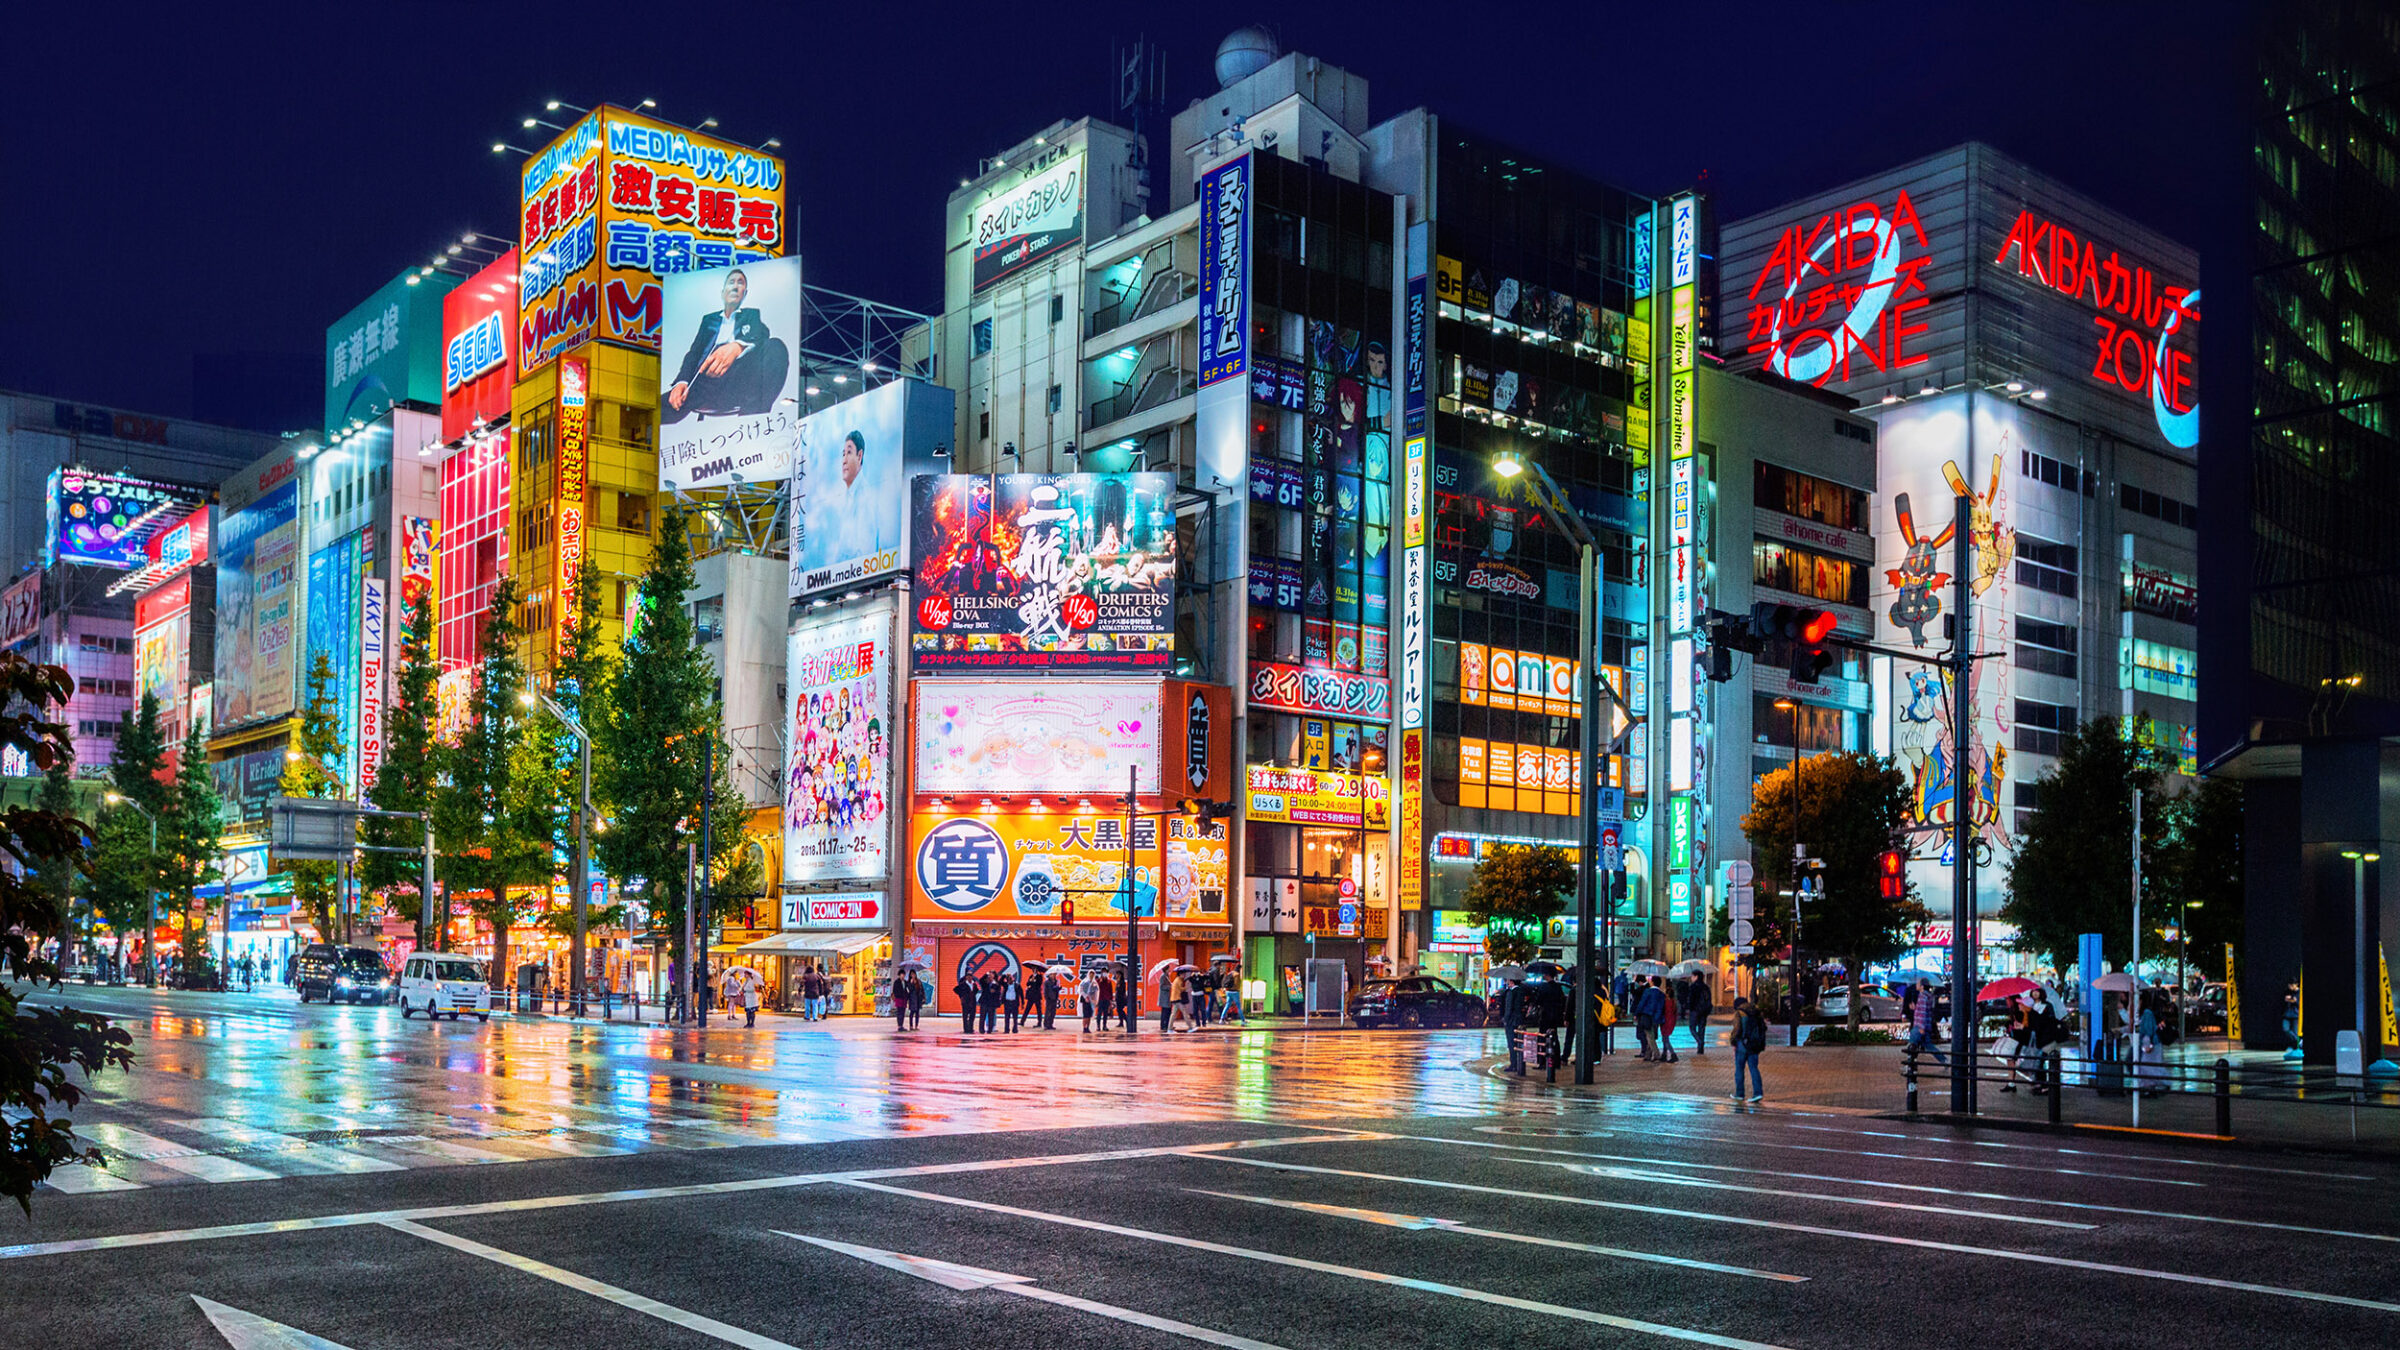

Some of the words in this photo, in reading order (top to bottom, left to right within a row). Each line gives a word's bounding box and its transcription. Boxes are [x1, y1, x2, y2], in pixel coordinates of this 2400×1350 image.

[609, 121, 780, 190] MEDIAリサイクル
[524, 155, 598, 254] 激安販売
[610, 161, 779, 243] 激安販売
[979, 171, 1076, 245] メイドカジノ
[1677, 205, 1691, 278] スーパービル
[1749, 190, 1929, 300] AKIBA
[1437, 270, 1461, 295] 8F
[1747, 256, 1931, 341] カルチャーズ
[522, 280, 597, 368] Mulan
[1203, 303, 1212, 362] 秋葉原店
[447, 310, 507, 392] SEGA
[1674, 325, 1686, 367] Yellow
[2092, 316, 2192, 414] ZONE
[1281, 384, 1304, 408] 7F
[563, 408, 583, 420] DVD
[1673, 379, 1687, 451] Submarine
[562, 428, 583, 440] ゲーム
[565, 441, 580, 449] CD
[1410, 446, 1421, 456] 3F
[561, 459, 582, 471] アニメ
[691, 453, 763, 483] DMM.com
[1436, 465, 1457, 485] 5F
[1676, 461, 1687, 471] 5F
[1278, 483, 1302, 506] 6F
[790, 423, 807, 596] 次は太陽か。
[1784, 519, 1823, 543] @home
[1826, 533, 1847, 549] cafe
[807, 564, 862, 589] DMM.make
[864, 548, 897, 575] solar
[1435, 562, 1456, 581] 5F
[953, 597, 1018, 609] HELLSING
[1277, 583, 1301, 606] 5F
[365, 583, 383, 641] AKKY
[953, 609, 980, 620] OVA
[1069, 598, 1094, 624] 11/30
[1098, 594, 1169, 606] DRIFTERS
[1098, 606, 1151, 617] COMICS
[1153, 605, 1162, 617] 6
[1306, 646, 1327, 657] Stars
[365, 657, 380, 736] Tax-free
[1254, 668, 1387, 714] メイドカジノ
[1309, 724, 1321, 735] 3F
[1306, 740, 1324, 751] 入口
[362, 739, 379, 786] Shop
[1462, 768, 1482, 780] Free
[1464, 757, 1480, 767] Tax
[1252, 773, 1314, 791] 全身もみほぐし
[1254, 797, 1282, 809] りらくる
[1413, 798, 1421, 830] TAX
[1015, 838, 1054, 850] チケット
[1061, 818, 1157, 850] 大黒屋
[930, 833, 997, 901] 質
[785, 897, 809, 926] ZIN
[812, 902, 845, 919] COMIC
[847, 902, 862, 918] ZIN
[1253, 907, 1297, 920] ルノアール
[1068, 939, 1121, 951] チケット
[1621, 928, 1641, 939] 1600
